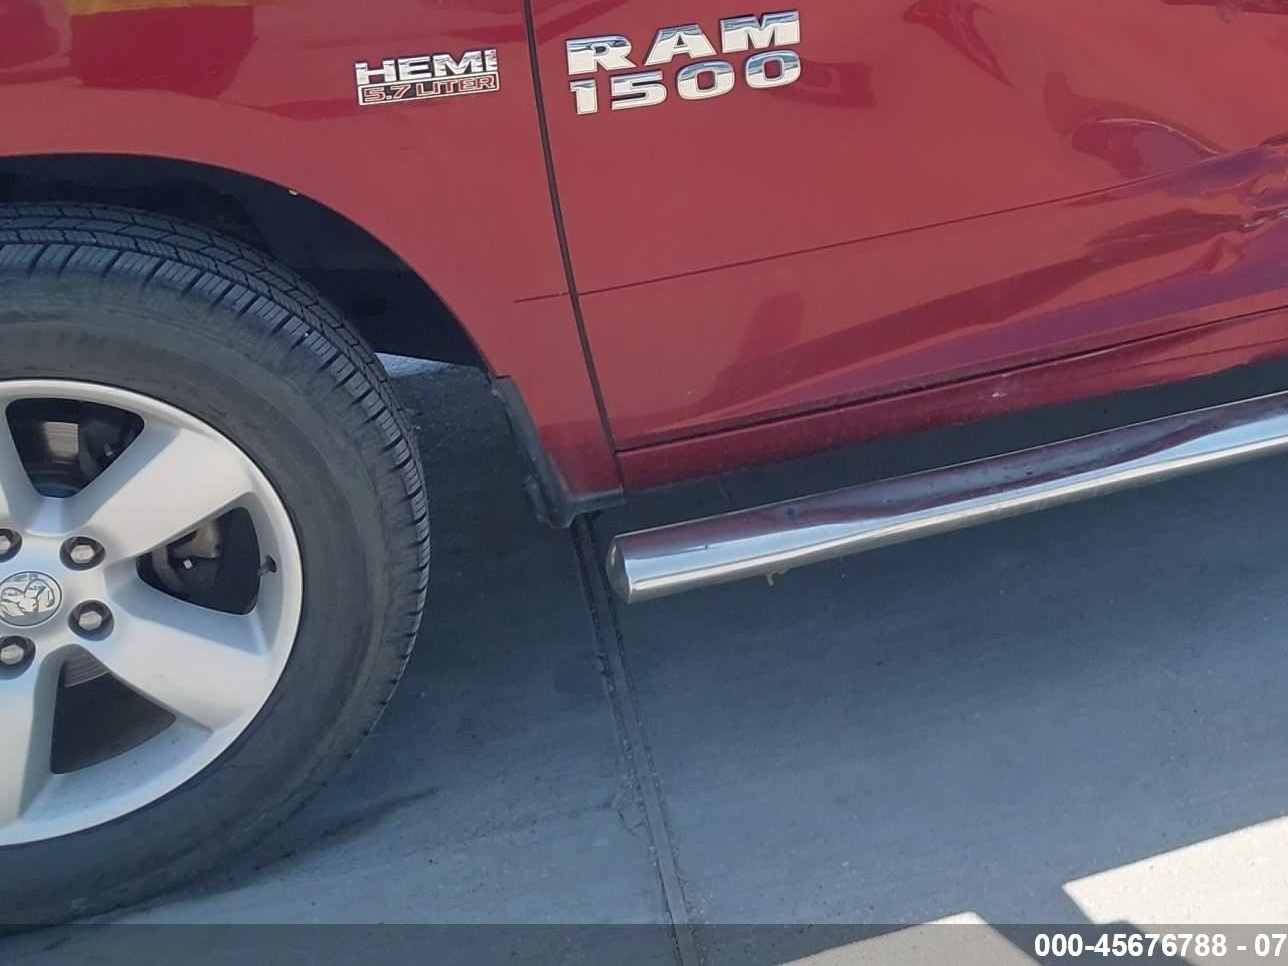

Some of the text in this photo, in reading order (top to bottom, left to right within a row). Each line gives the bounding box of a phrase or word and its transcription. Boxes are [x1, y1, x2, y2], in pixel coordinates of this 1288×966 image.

[355, 49, 498, 84] HEMI
[566, 10, 800, 75] RAM
[364, 75, 496, 102] 5.7 LITER
[570, 49, 801, 115] 1500
